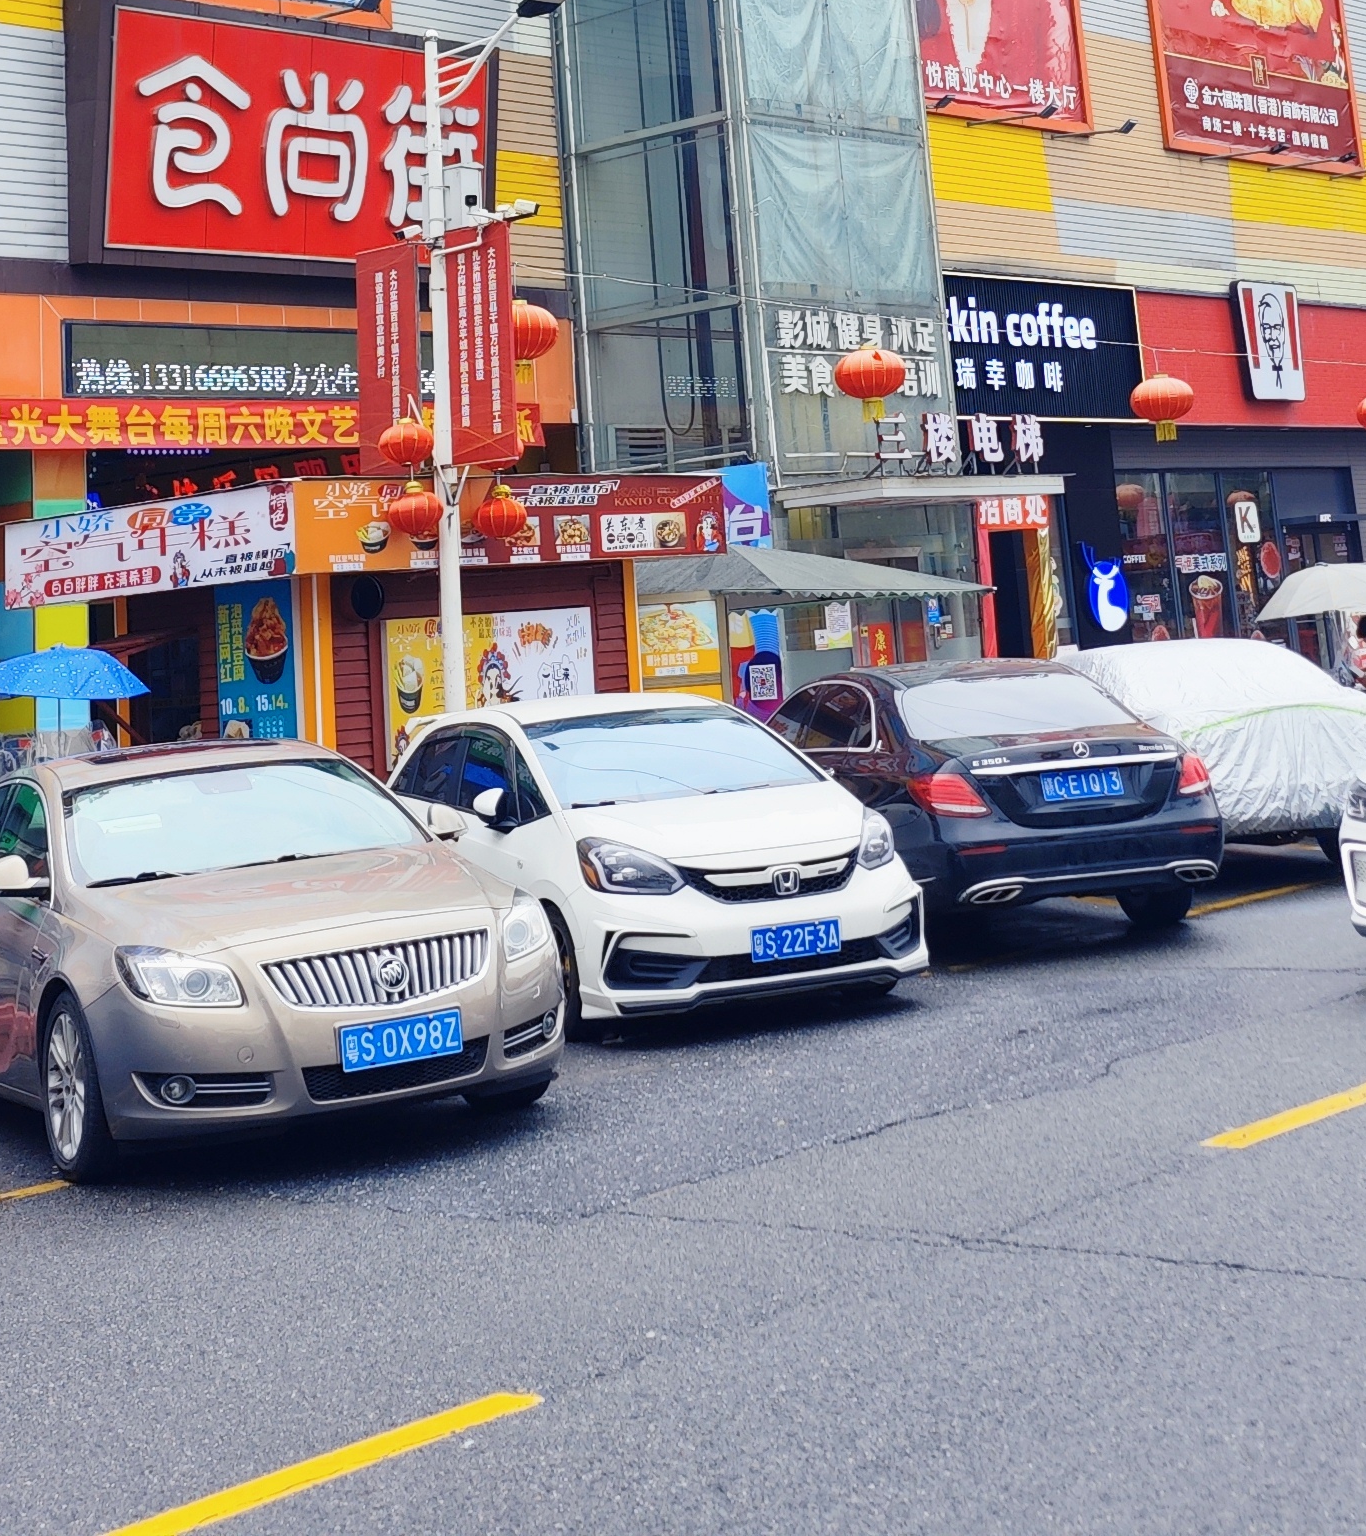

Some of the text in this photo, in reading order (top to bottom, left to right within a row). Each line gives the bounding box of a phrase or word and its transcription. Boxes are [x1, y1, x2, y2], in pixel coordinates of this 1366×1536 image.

[920, 58, 1077, 112] 悦商业中心一楼大厅
[778, 309, 938, 353] 影城 健身 沐足
[946, 295, 1098, 350] kin coffee
[779, 354, 835, 398] 美食
[956, 357, 1065, 393] 瑞幸咖啡
[875, 411, 1046, 464] 三楼电梯
[268, 492, 289, 531] 特色
[511, 494, 599, 506] 未被超越
[979, 495, 1050, 526] 招商处
[1123, 554, 1147, 564] COFFEE
[51, 567, 153, 596] 白白胖胖 充满希望
[753, 923, 839, 957] 粤S·22F3A
